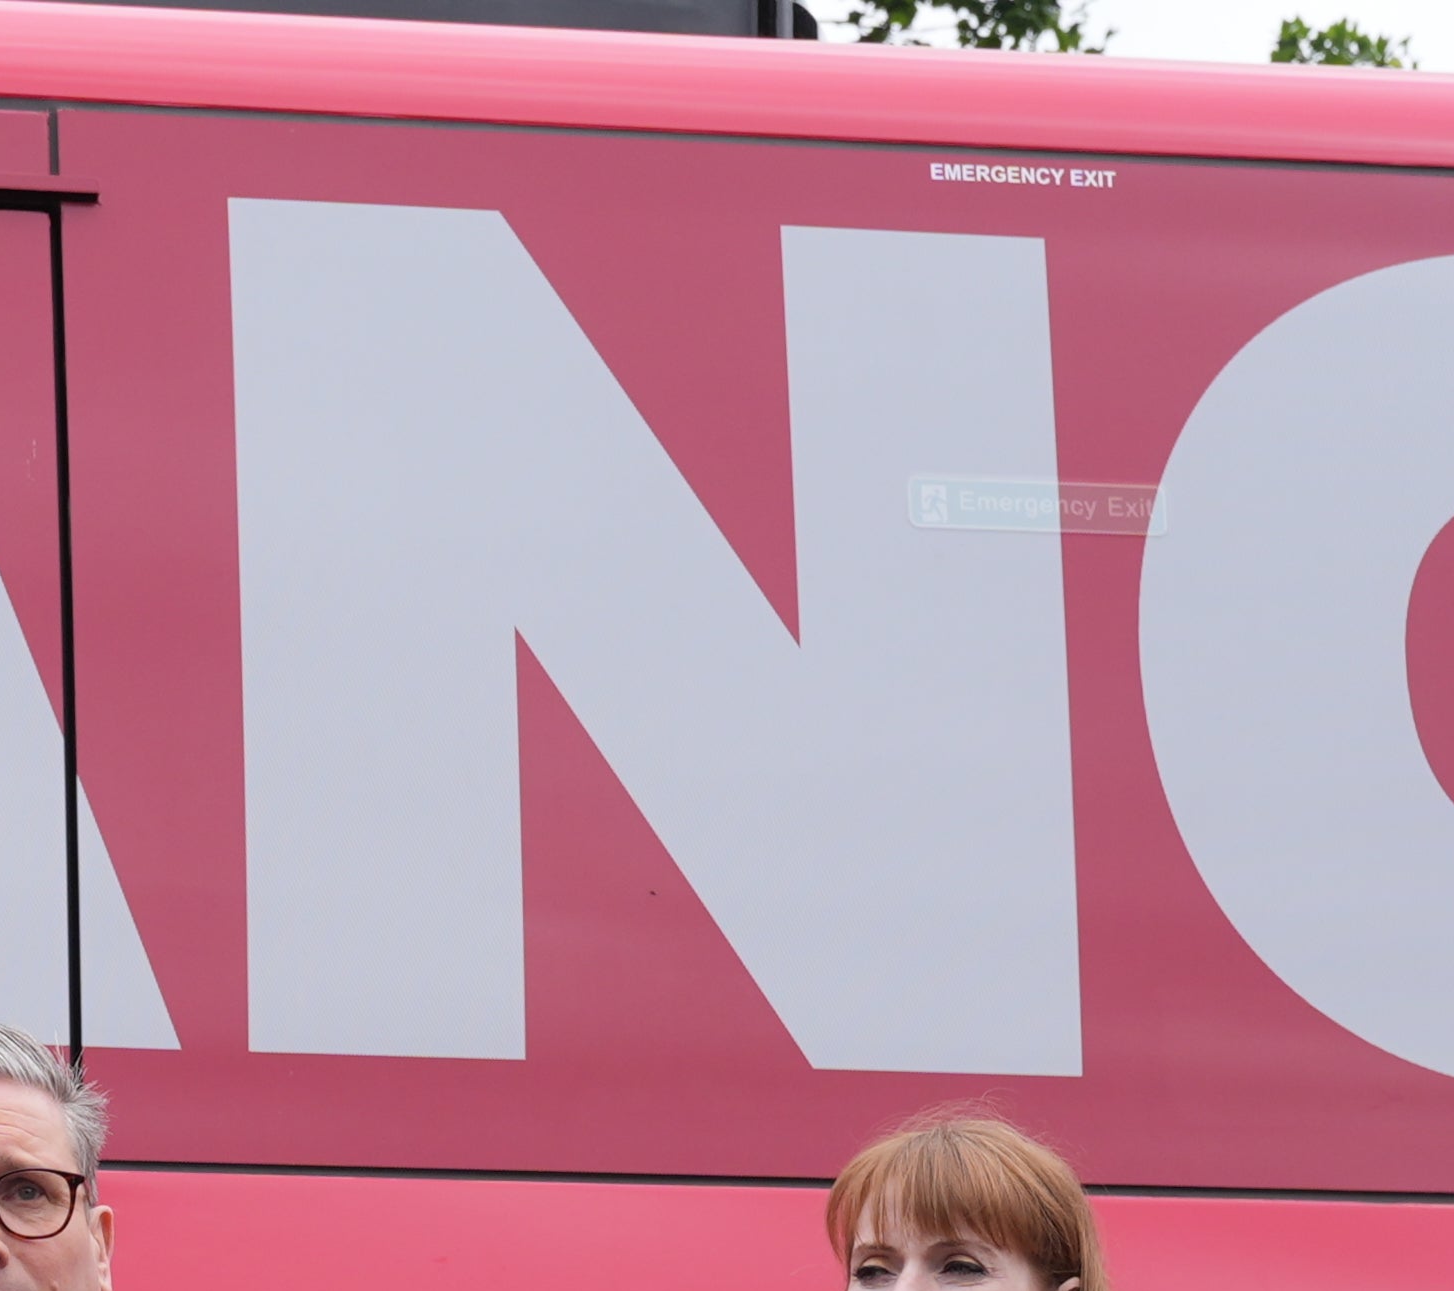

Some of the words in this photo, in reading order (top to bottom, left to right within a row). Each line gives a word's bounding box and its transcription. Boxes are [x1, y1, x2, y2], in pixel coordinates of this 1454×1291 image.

[931, 163, 1064, 185] EMERGENCY
[1070, 169, 1116, 187] EXIT
[960, 491, 1097, 520] Emergency
[1108, 496, 1154, 518] Exit
